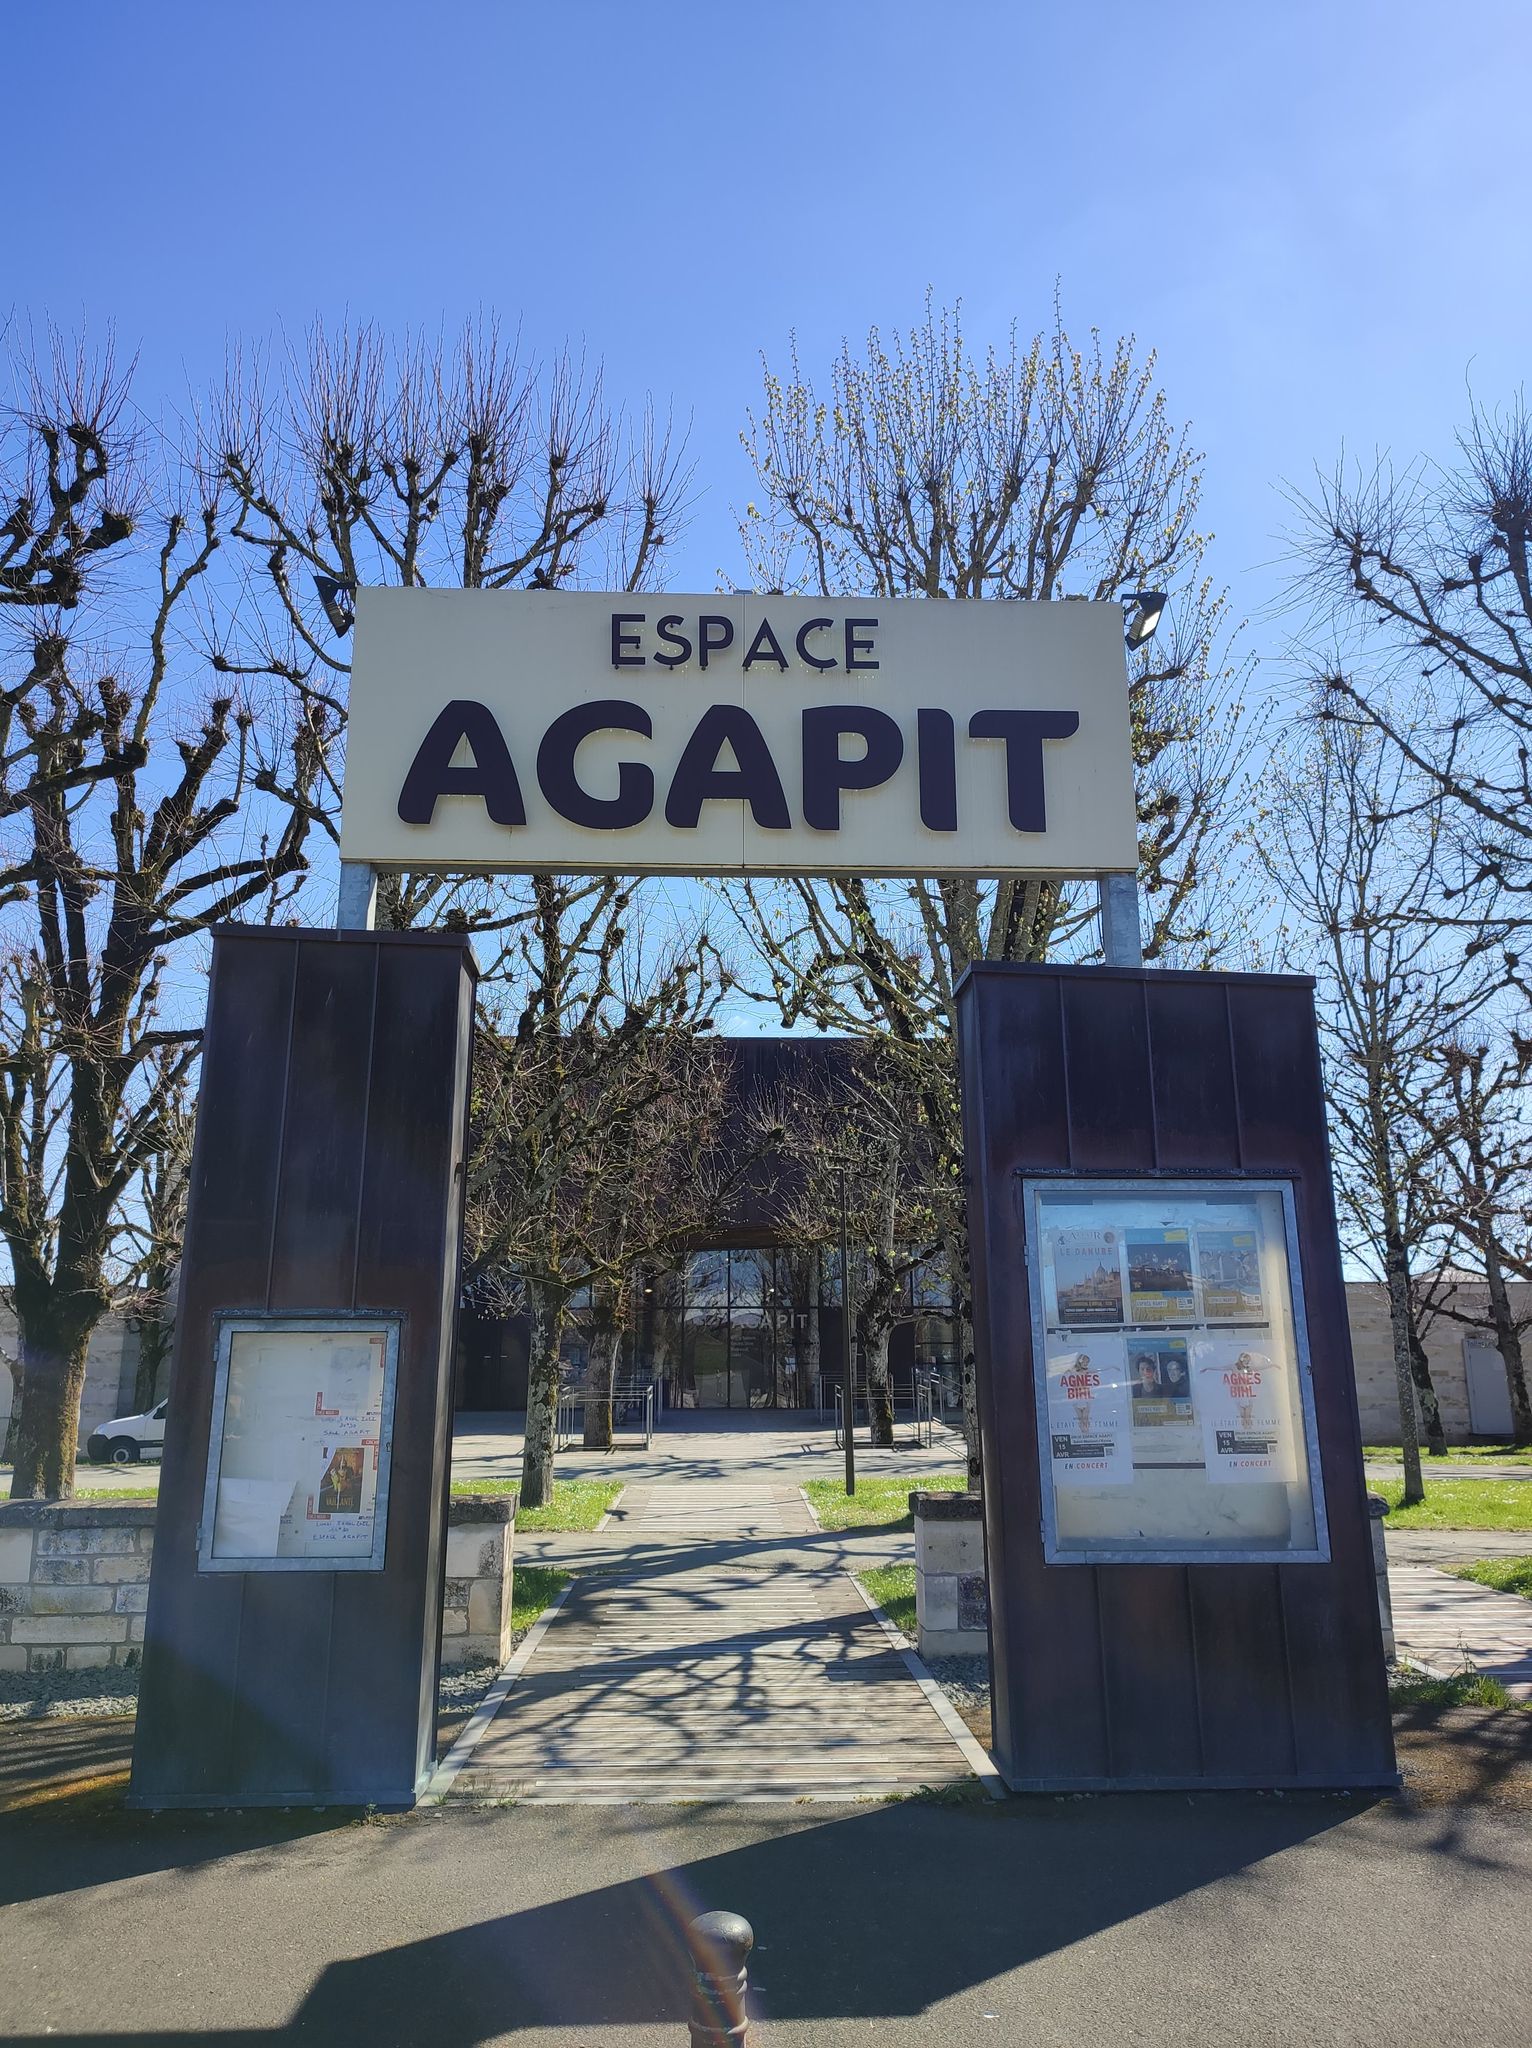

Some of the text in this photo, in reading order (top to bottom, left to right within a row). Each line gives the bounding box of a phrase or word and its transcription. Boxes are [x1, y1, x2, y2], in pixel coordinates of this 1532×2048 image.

[612, 613, 880, 671] ESPACE
[397, 700, 1080, 833] AGAPIT
[1060, 1247, 1113, 1256] LE DANUBE
[1068, 1388, 1095, 1399] BIHL
[1231, 1385, 1256, 1398] BIHL
[1076, 1462, 1108, 1470] CONCERT
